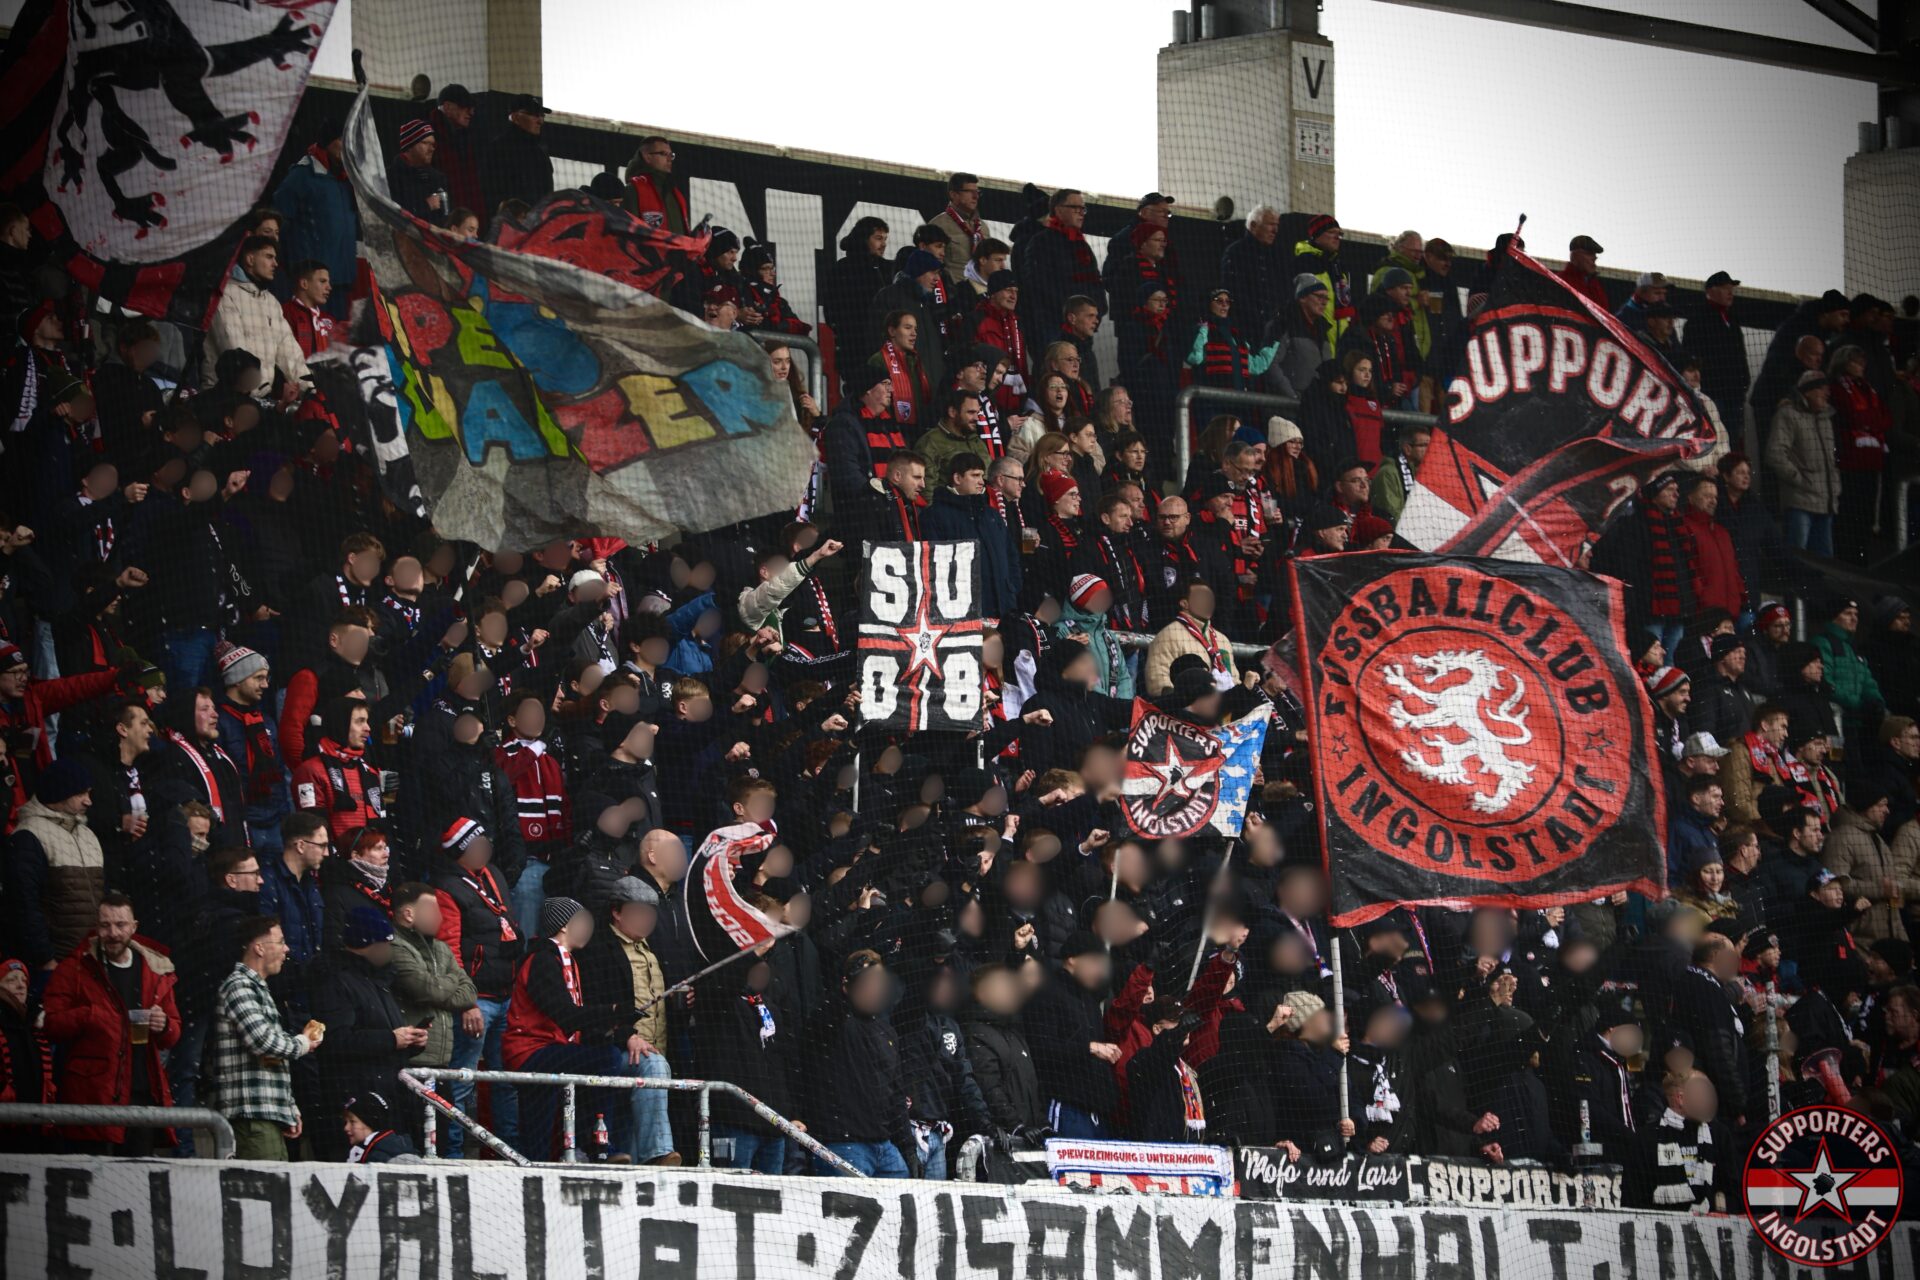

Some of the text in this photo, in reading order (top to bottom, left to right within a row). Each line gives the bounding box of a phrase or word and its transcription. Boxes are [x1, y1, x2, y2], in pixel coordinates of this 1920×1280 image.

[1302, 56, 1325, 99] V
[1323, 577, 1610, 718] FUSSBALLCLUB
[1335, 763, 1617, 872] INGOLSTADT
[1056, 1148, 1215, 1166] SPIELVEREINIGUNG UNTERHACHING
[1306, 1153, 1352, 1187] und
[1357, 1155, 1403, 1192] Lars
[149, 1168, 782, 1280] LOYALITÄT
